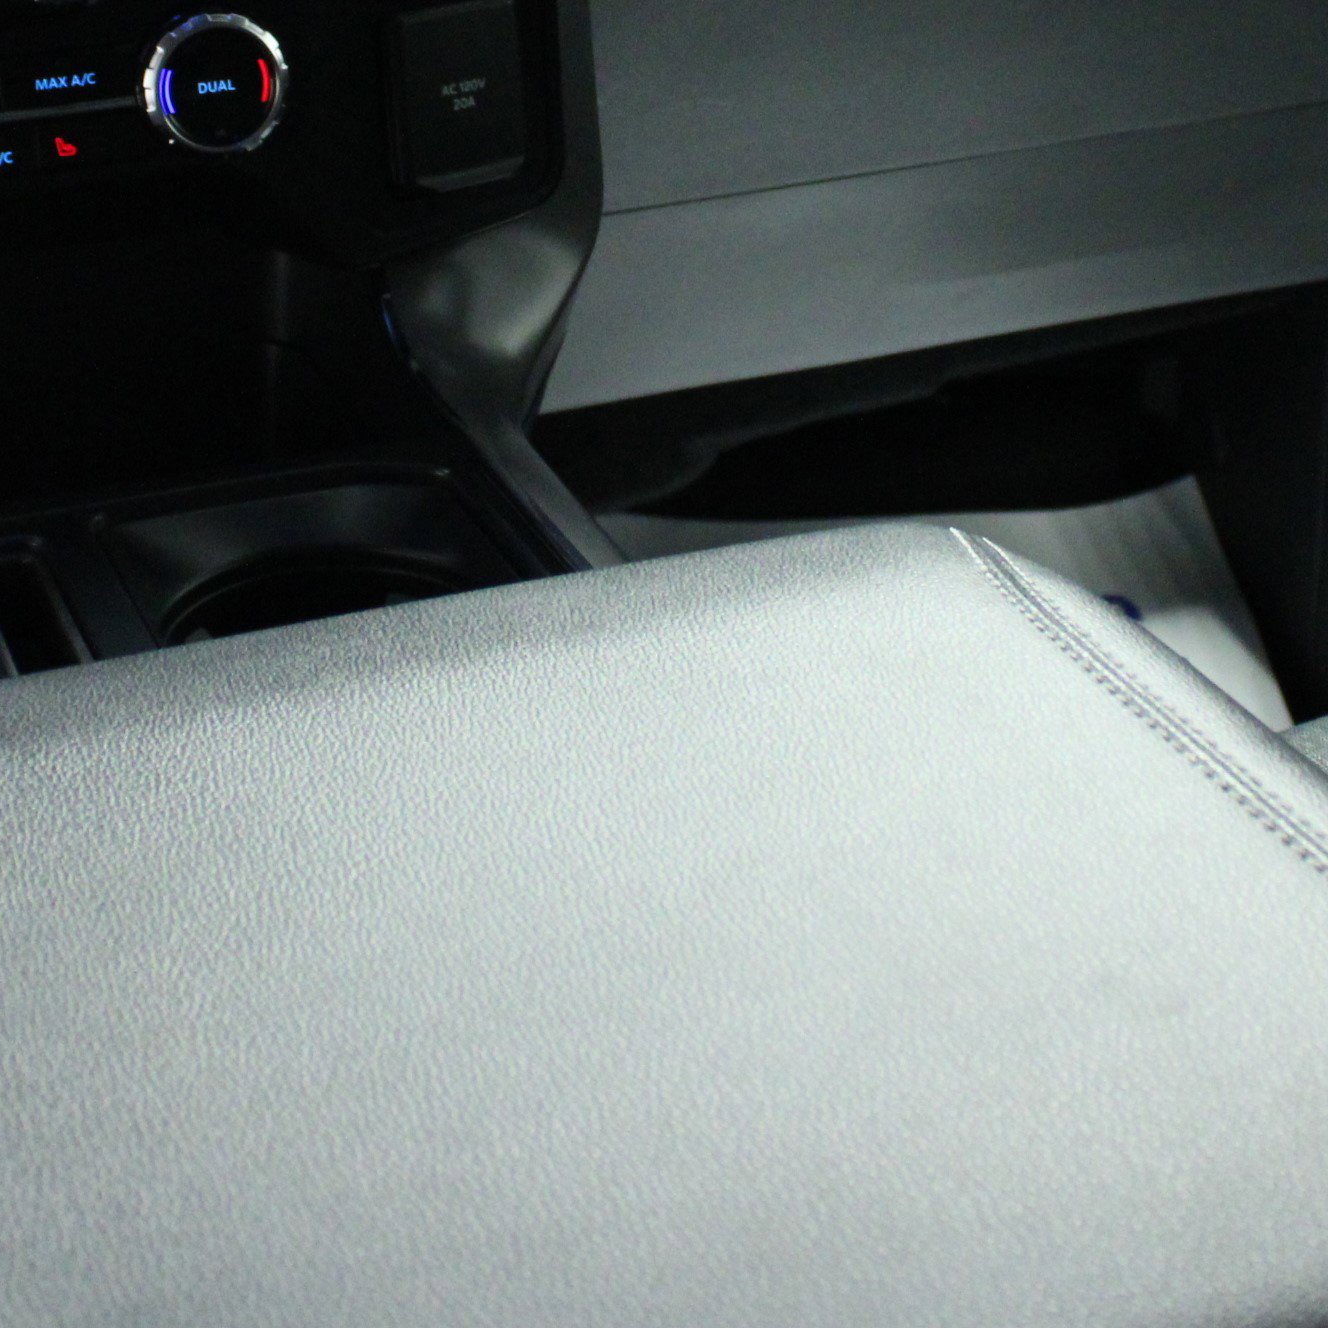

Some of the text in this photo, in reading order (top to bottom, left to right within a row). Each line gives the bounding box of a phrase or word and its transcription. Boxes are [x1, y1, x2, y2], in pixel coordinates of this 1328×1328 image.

[35, 72, 96, 91] MAX A/C
[197, 79, 236, 95] DUAL
